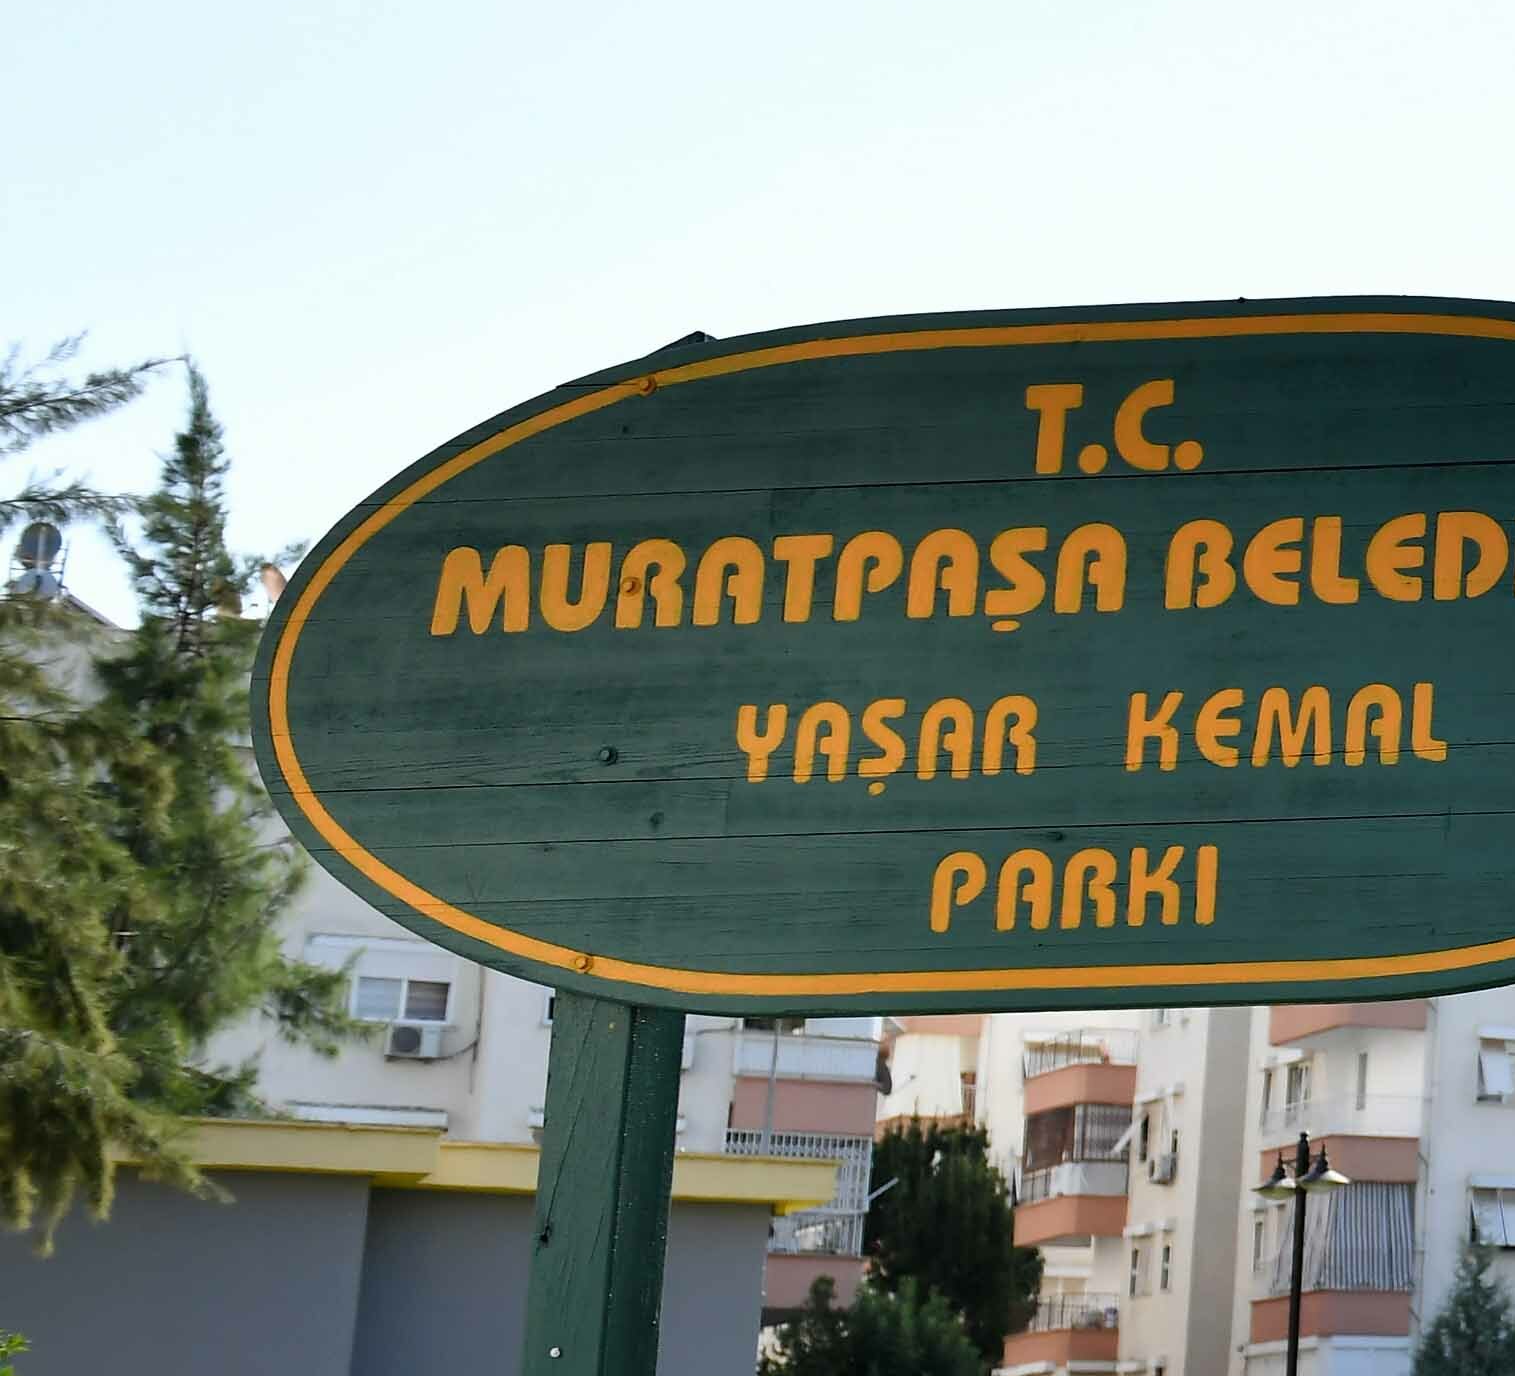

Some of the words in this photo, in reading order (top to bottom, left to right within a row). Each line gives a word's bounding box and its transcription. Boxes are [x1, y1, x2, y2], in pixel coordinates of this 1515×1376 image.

[1028, 381, 1202, 474] T.C.
[431, 523, 1127, 636] MURATPAŞA
[737, 695, 1037, 795] YAŞAR
[1126, 684, 1447, 771] KEMAL
[931, 845, 1218, 933] PARKI
